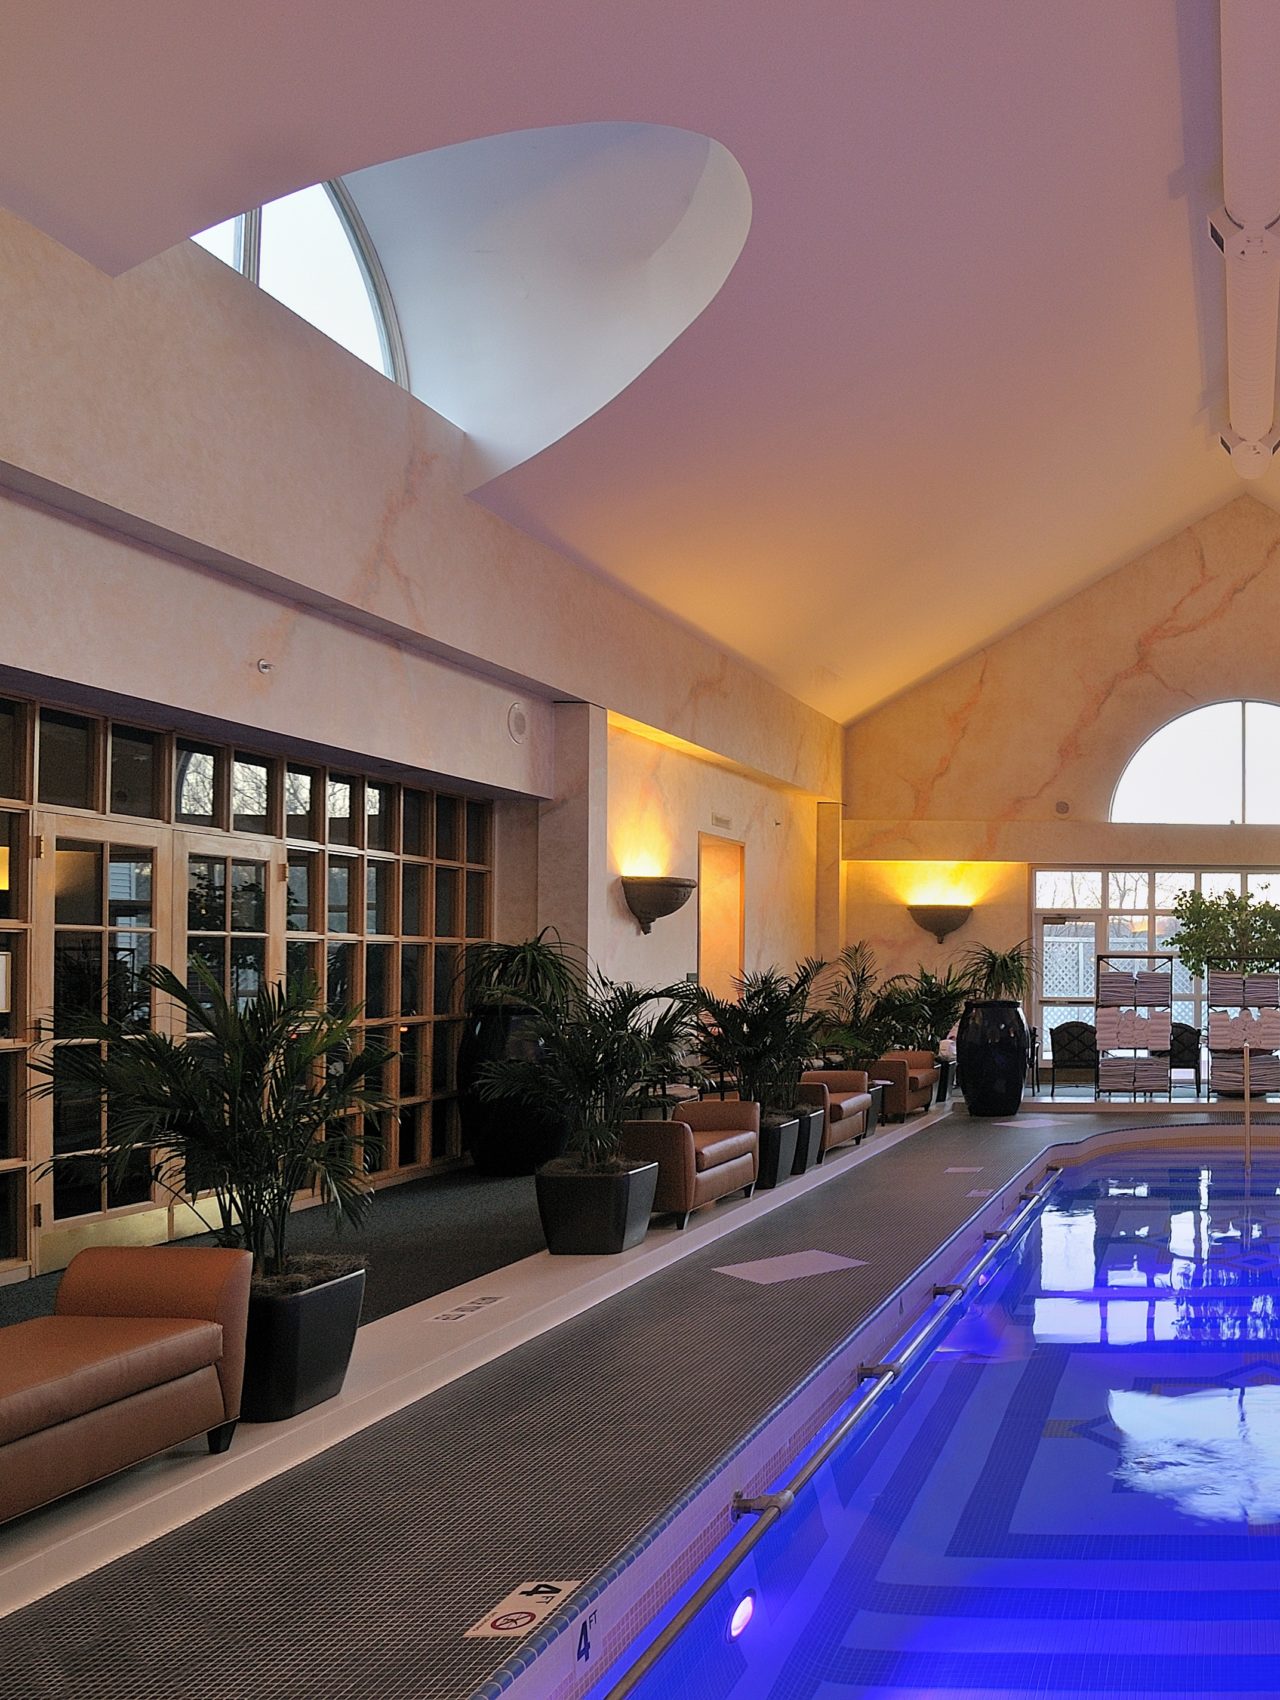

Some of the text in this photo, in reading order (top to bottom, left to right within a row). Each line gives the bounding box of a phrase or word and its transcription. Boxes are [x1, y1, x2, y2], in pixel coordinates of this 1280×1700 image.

[519, 1584, 562, 1604] 4 FT
[577, 1609, 597, 1662] 4 FT
